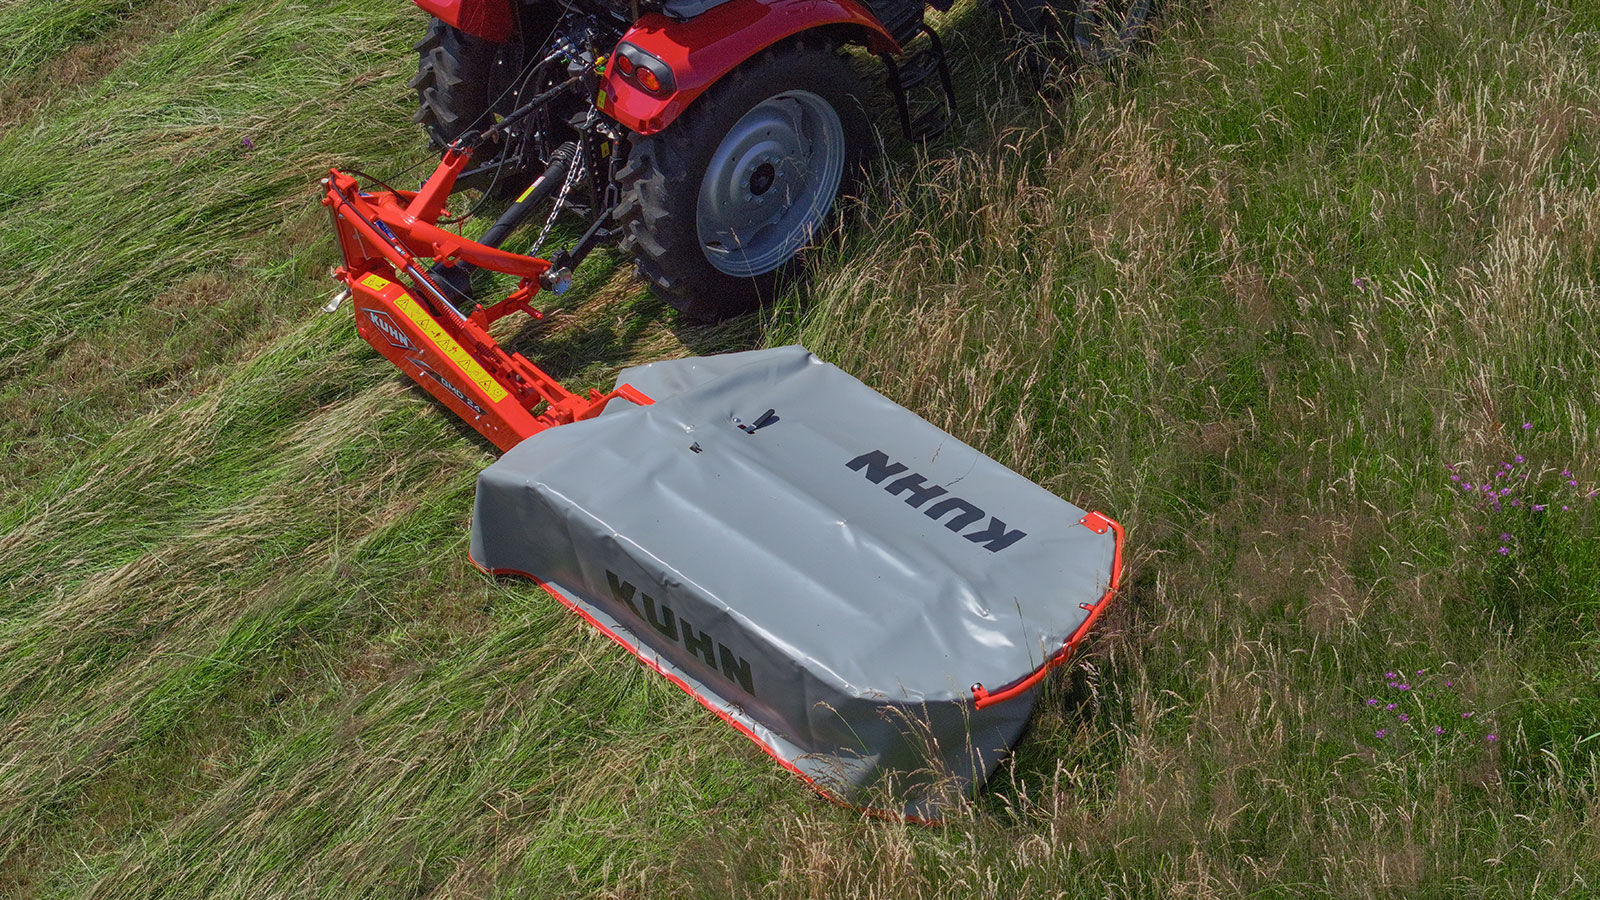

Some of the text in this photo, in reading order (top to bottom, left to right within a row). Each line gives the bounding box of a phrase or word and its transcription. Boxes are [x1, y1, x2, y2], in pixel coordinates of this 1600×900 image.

[370, 311, 409, 348] KUHN
[845, 449, 1027, 553] KUHN
[606, 569, 756, 697] KUHN
